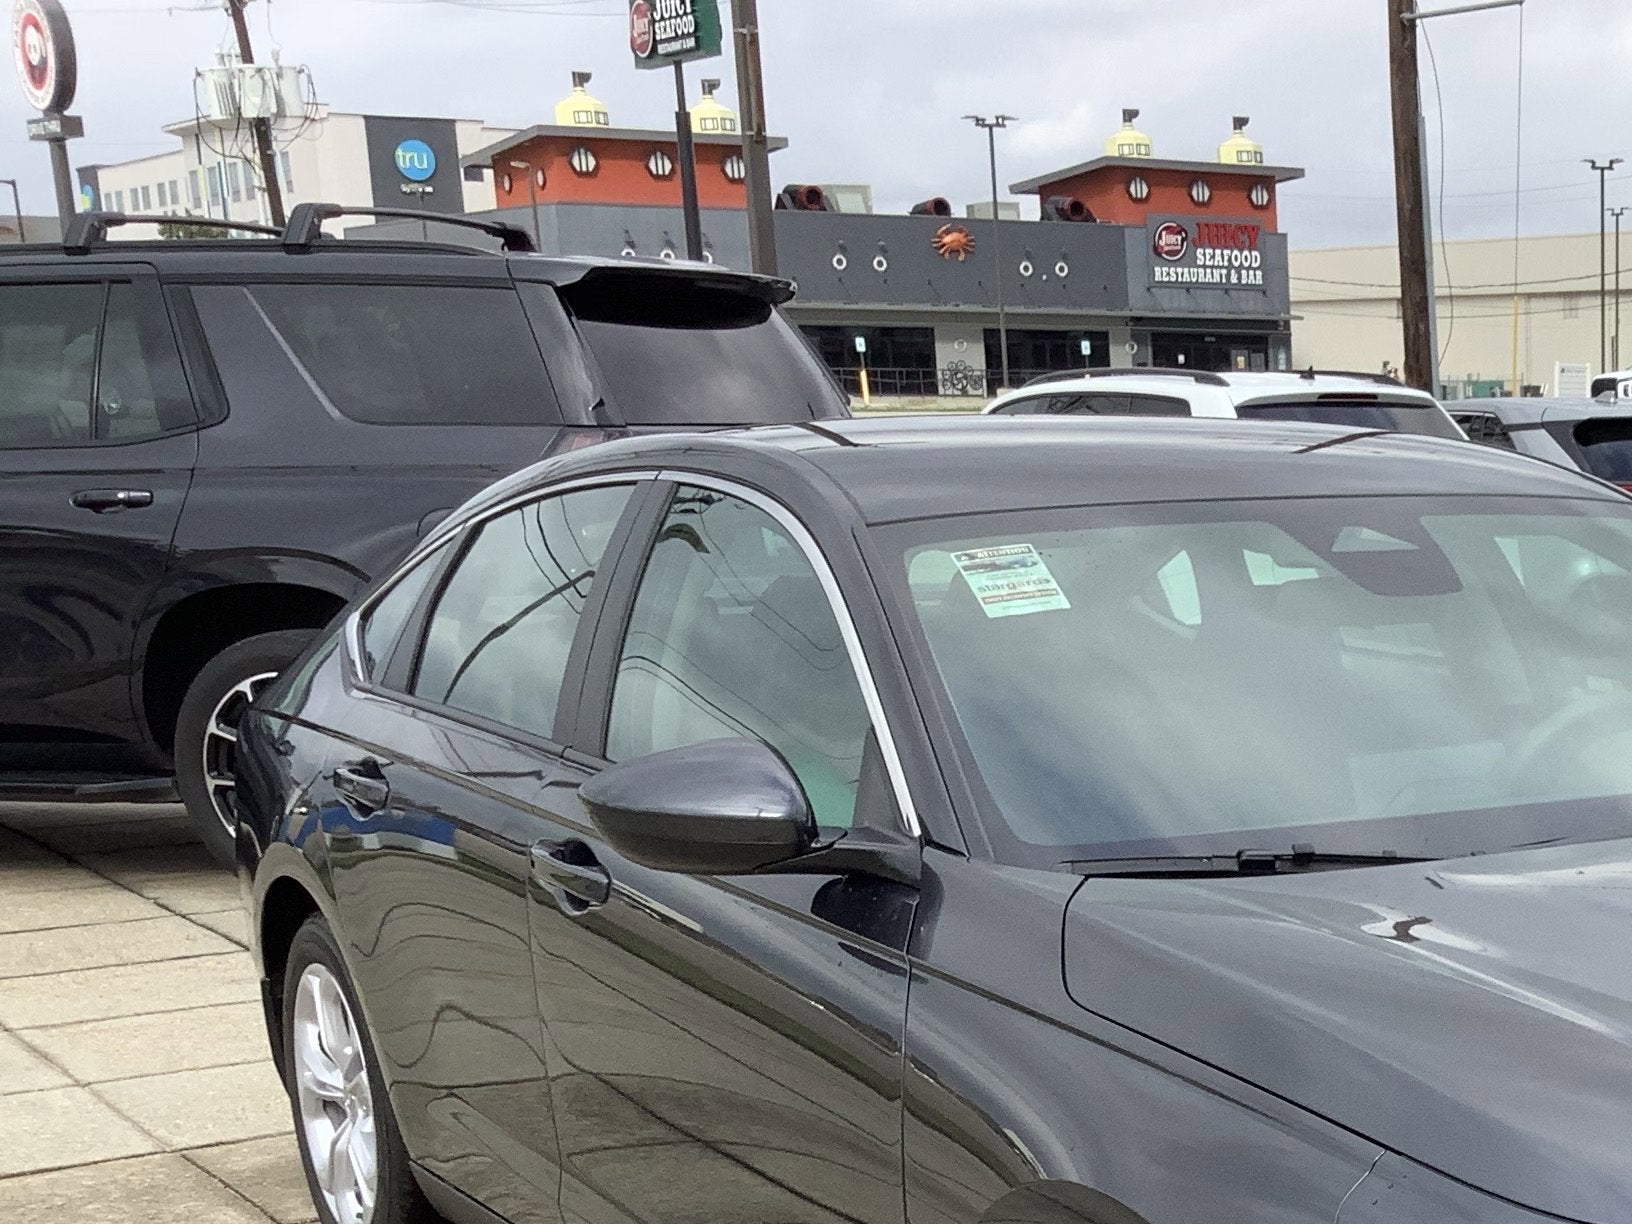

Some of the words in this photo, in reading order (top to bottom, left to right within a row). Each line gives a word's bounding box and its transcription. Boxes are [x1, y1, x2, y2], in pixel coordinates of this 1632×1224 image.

[655, 14, 695, 40] SEAFOOD
[395, 148, 428, 169] tru
[1192, 221, 1260, 249] JUICY
[1196, 248, 1261, 268] SEAFOOD
[1154, 266, 1228, 284] RESTAURANT
[1230, 268, 1239, 284] &
[1241, 269, 1264, 285] BAR
